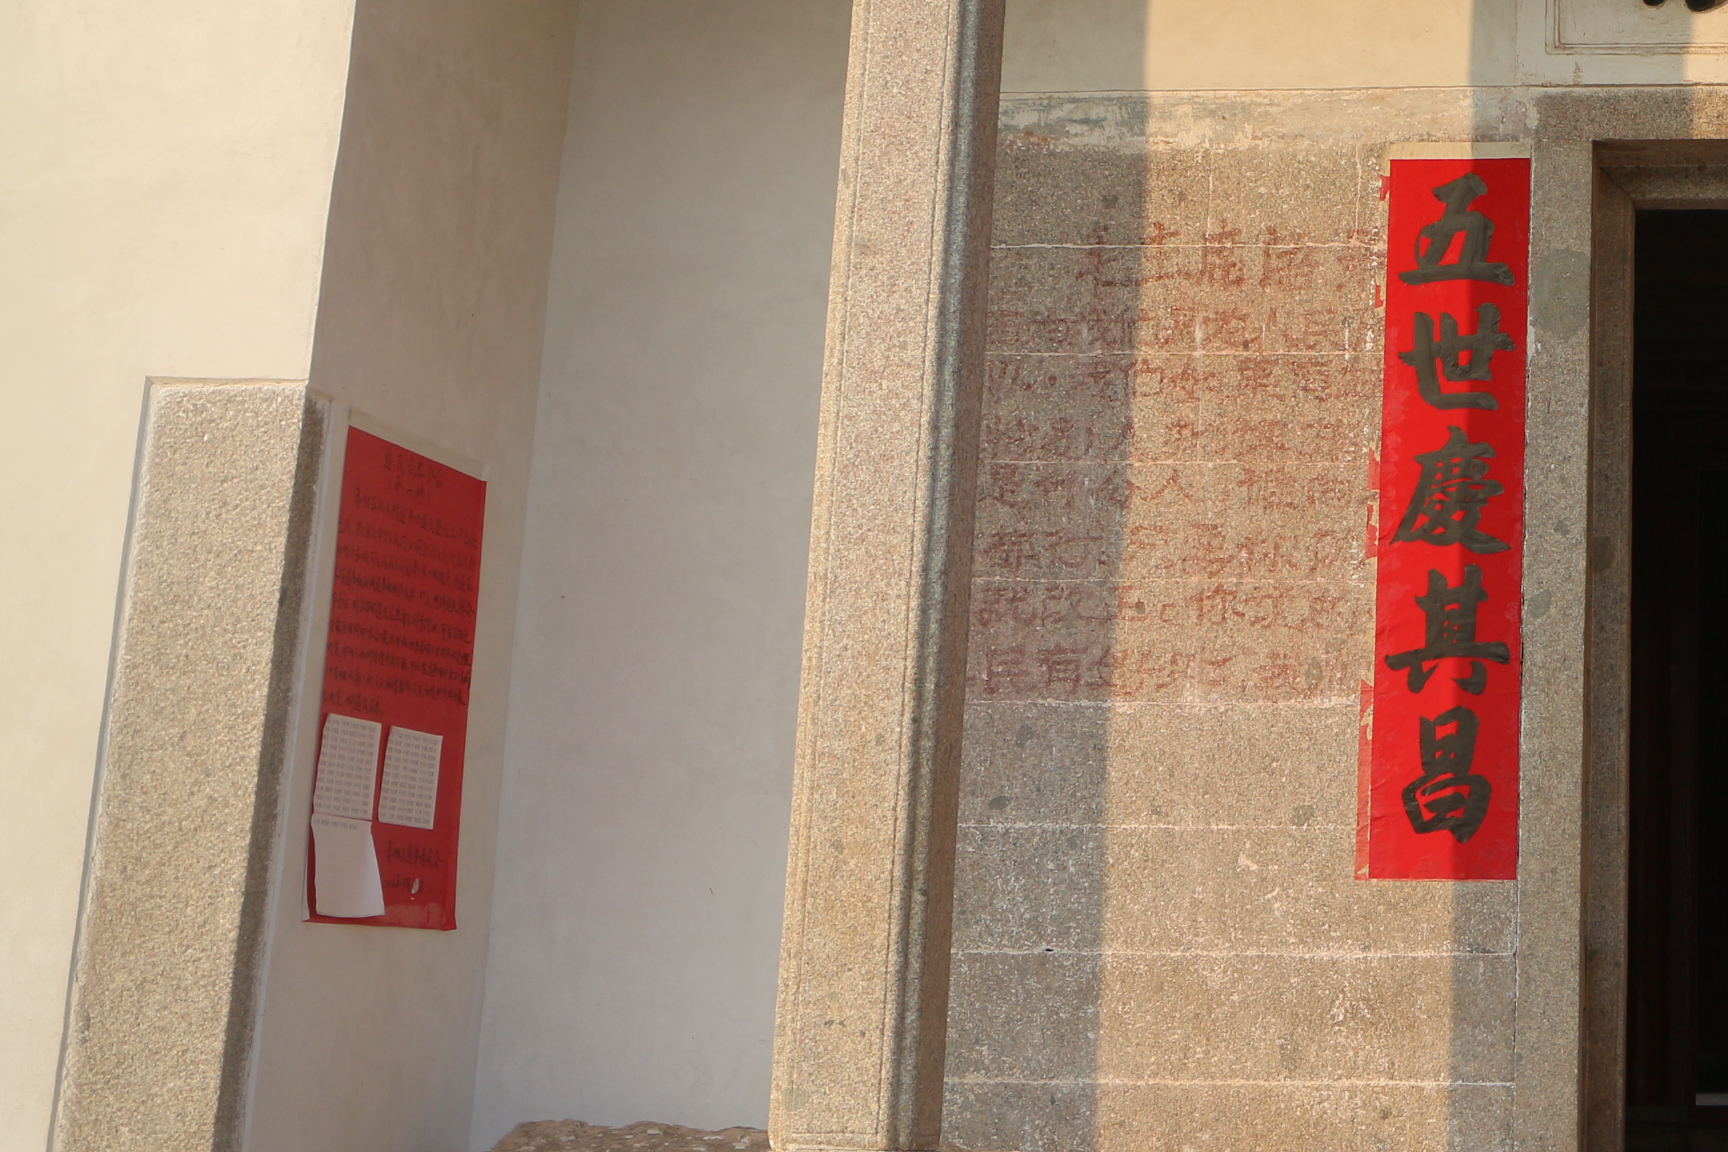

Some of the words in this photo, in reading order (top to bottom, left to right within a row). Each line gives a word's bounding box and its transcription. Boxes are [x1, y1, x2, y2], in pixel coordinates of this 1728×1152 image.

[1386, 171, 1517, 845] 五世慶其昌
